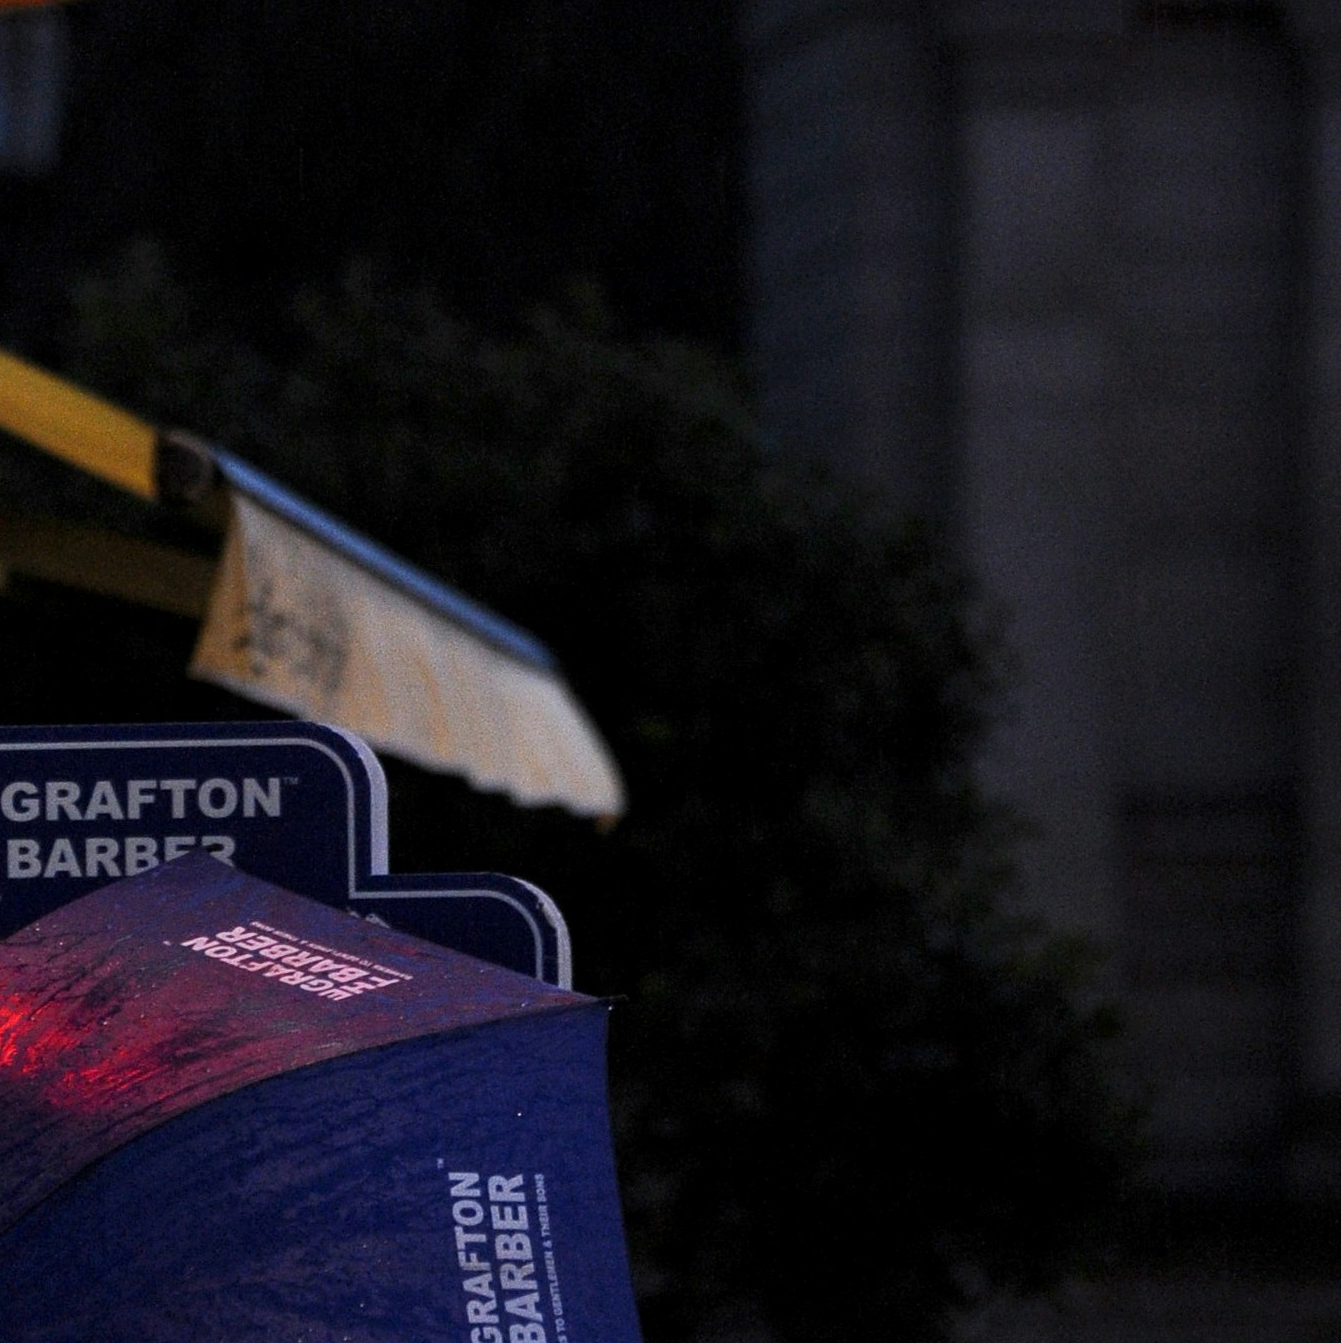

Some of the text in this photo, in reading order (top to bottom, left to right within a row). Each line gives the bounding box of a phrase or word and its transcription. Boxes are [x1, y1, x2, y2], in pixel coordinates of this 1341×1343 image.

[0, 776, 283, 823] GRAFTON
[180, 935, 335, 994] GRAFTON
[216, 925, 370, 983] BARBER
[316, 974, 401, 1002] THE
